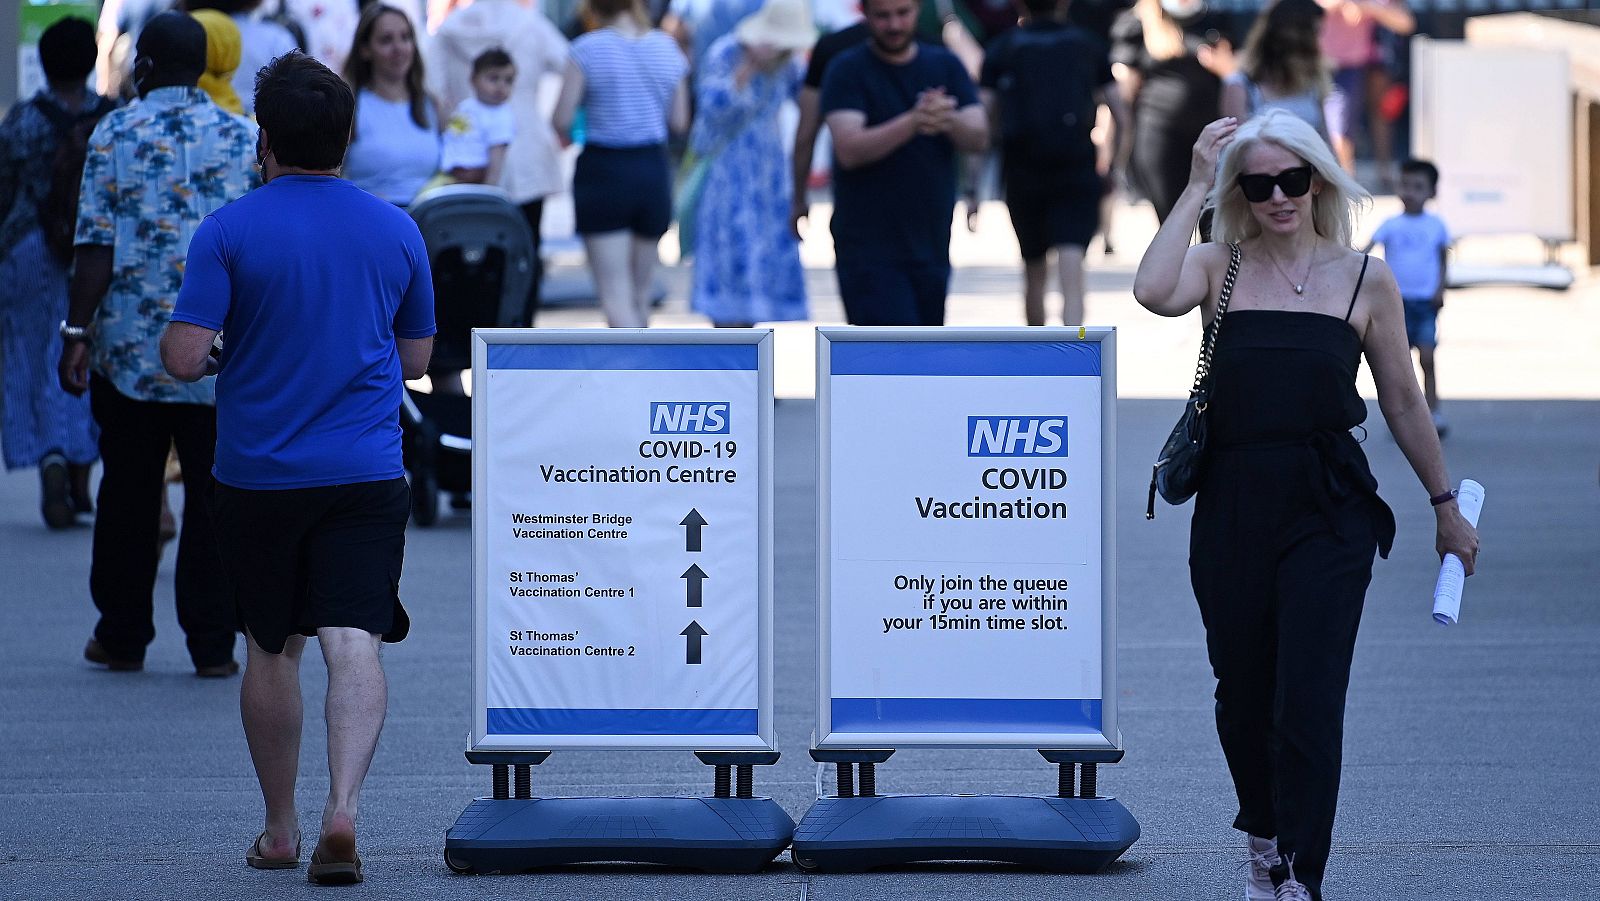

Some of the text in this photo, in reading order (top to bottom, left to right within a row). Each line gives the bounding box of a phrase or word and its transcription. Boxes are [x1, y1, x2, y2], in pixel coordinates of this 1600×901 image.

[652, 404, 727, 432] NHS
[970, 419, 1064, 454] NHS
[639, 440, 737, 459] COVID-19
[539, 464, 737, 484] Vaccination Centre
[981, 467, 1067, 490] COVID
[914, 496, 1067, 519] Vaccination
[511, 513, 633, 527] Westminster Bridge
[512, 527, 628, 539] Vaccination Centre
[509, 571, 523, 583] St
[894, 574, 1068, 594] Only join the queue
[509, 586, 634, 598] Vaccination Centre 1
[923, 593, 1068, 613] if you are within
[882, 614, 1068, 634] your 15min time slot.
[509, 630, 523, 641] St
[509, 645, 635, 657] Vaccination Centre 2
